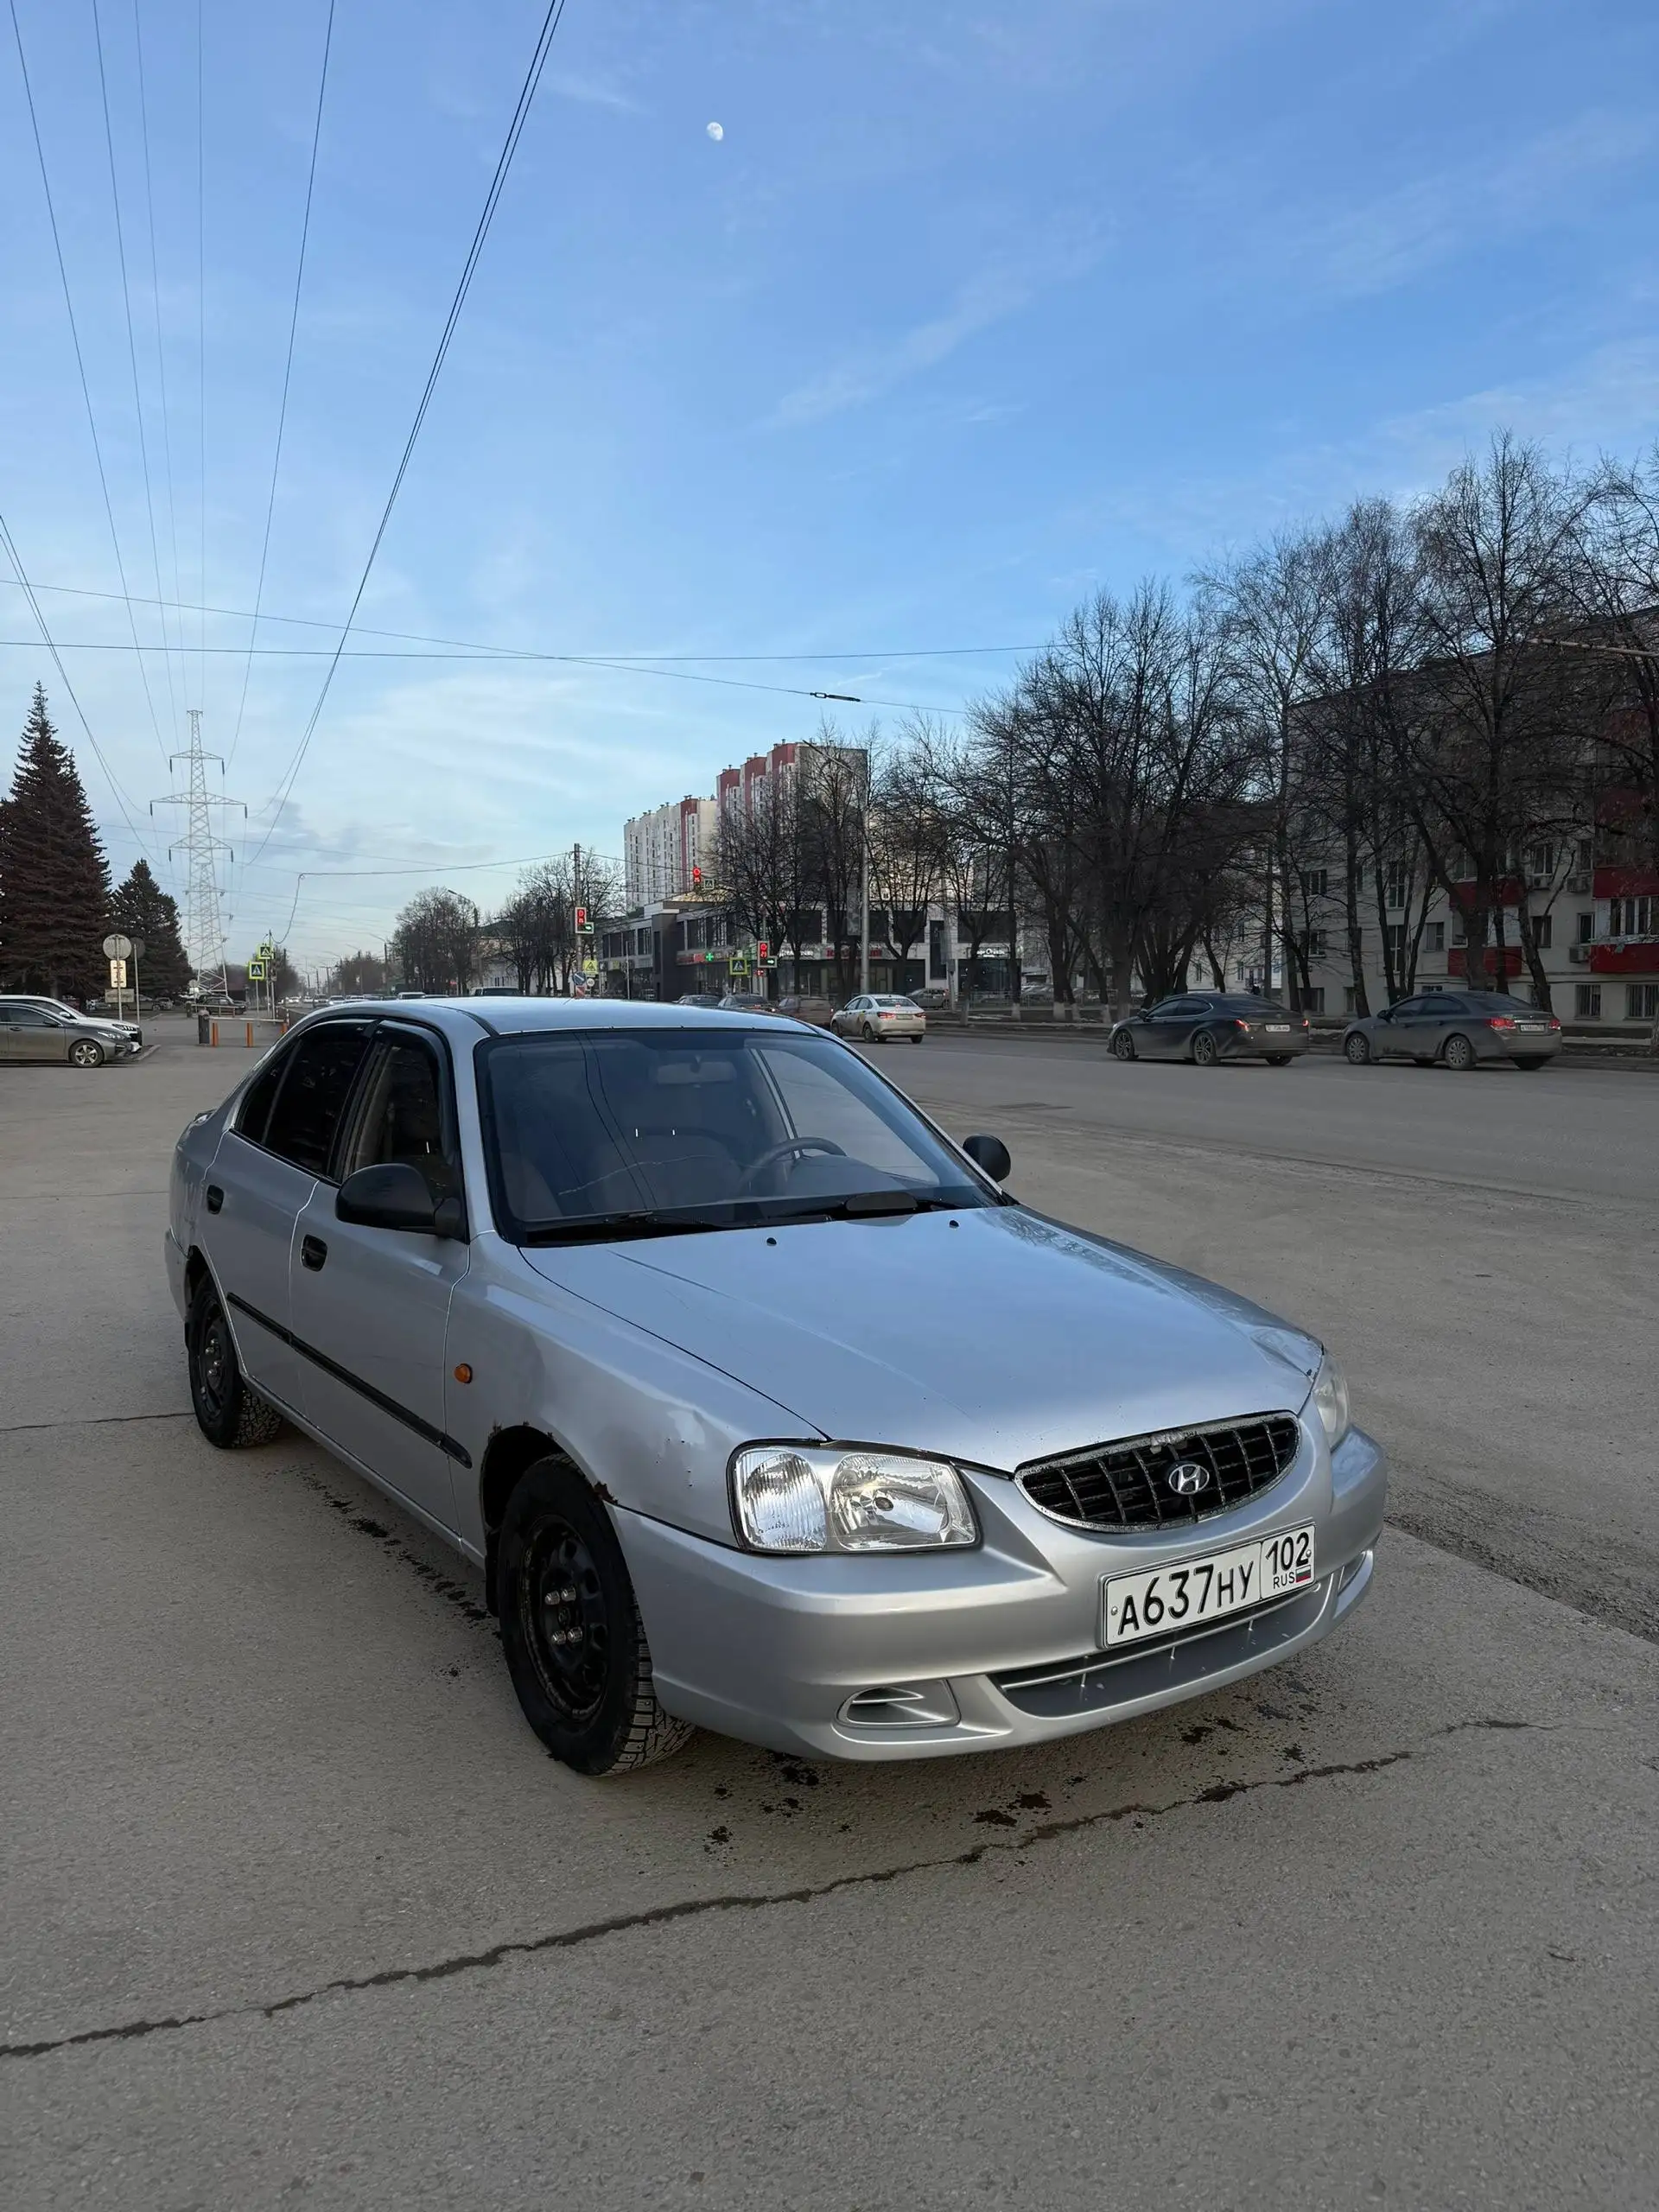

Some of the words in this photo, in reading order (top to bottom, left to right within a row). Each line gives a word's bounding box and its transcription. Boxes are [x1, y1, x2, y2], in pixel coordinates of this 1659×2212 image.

[1265, 1532, 1310, 1573] 102
[1117, 1560, 1255, 1636] А637НУ
[1273, 1572, 1295, 1590] RUS
